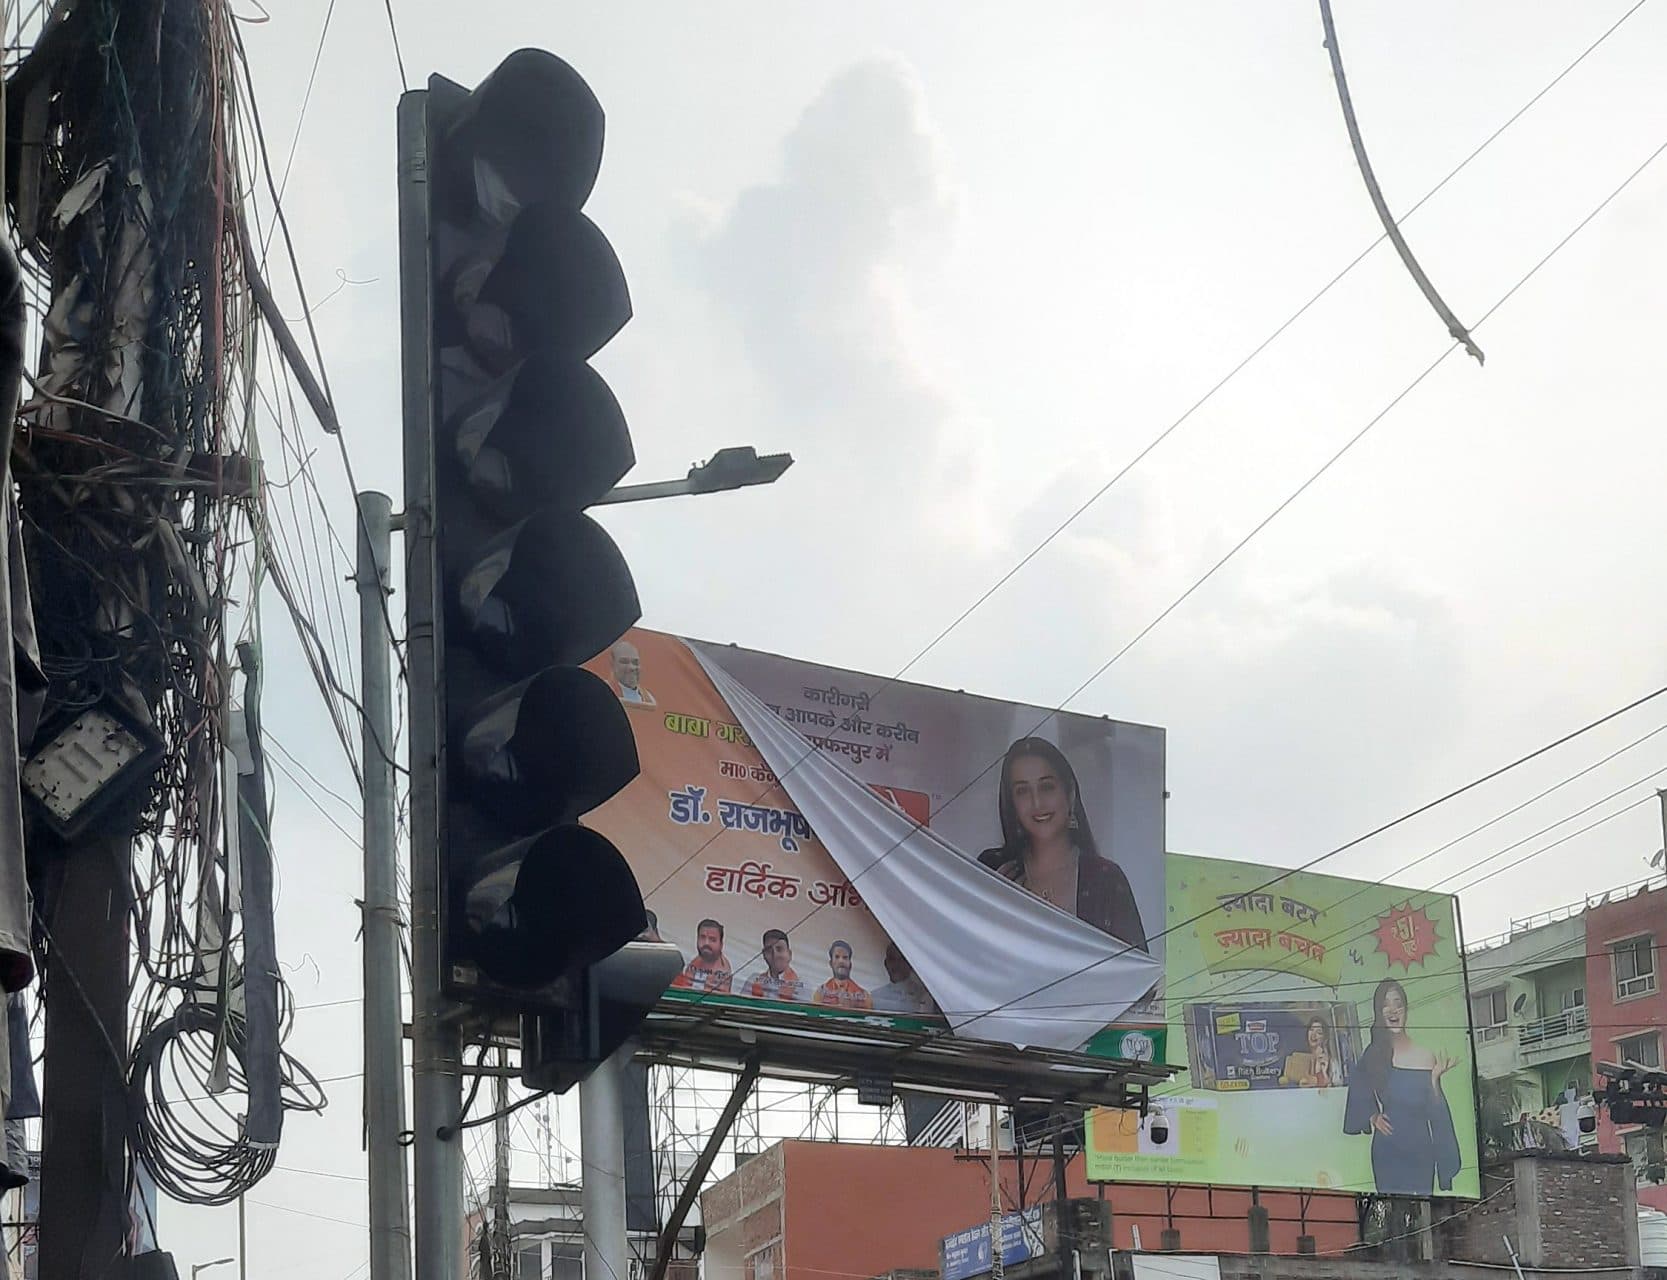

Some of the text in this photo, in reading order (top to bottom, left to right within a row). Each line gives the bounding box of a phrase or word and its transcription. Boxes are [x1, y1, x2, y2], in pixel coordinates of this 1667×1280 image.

[803, 686, 871, 711] कारीगरी
[664, 712, 711, 738] बाबा
[785, 707, 837, 728] आपके
[839, 714, 873, 735] और
[875, 744, 893, 762] में
[719, 799, 813, 852] राजभूष
[705, 860, 801, 900] हार्दिक
[1235, 1032, 1279, 1055] TOP
